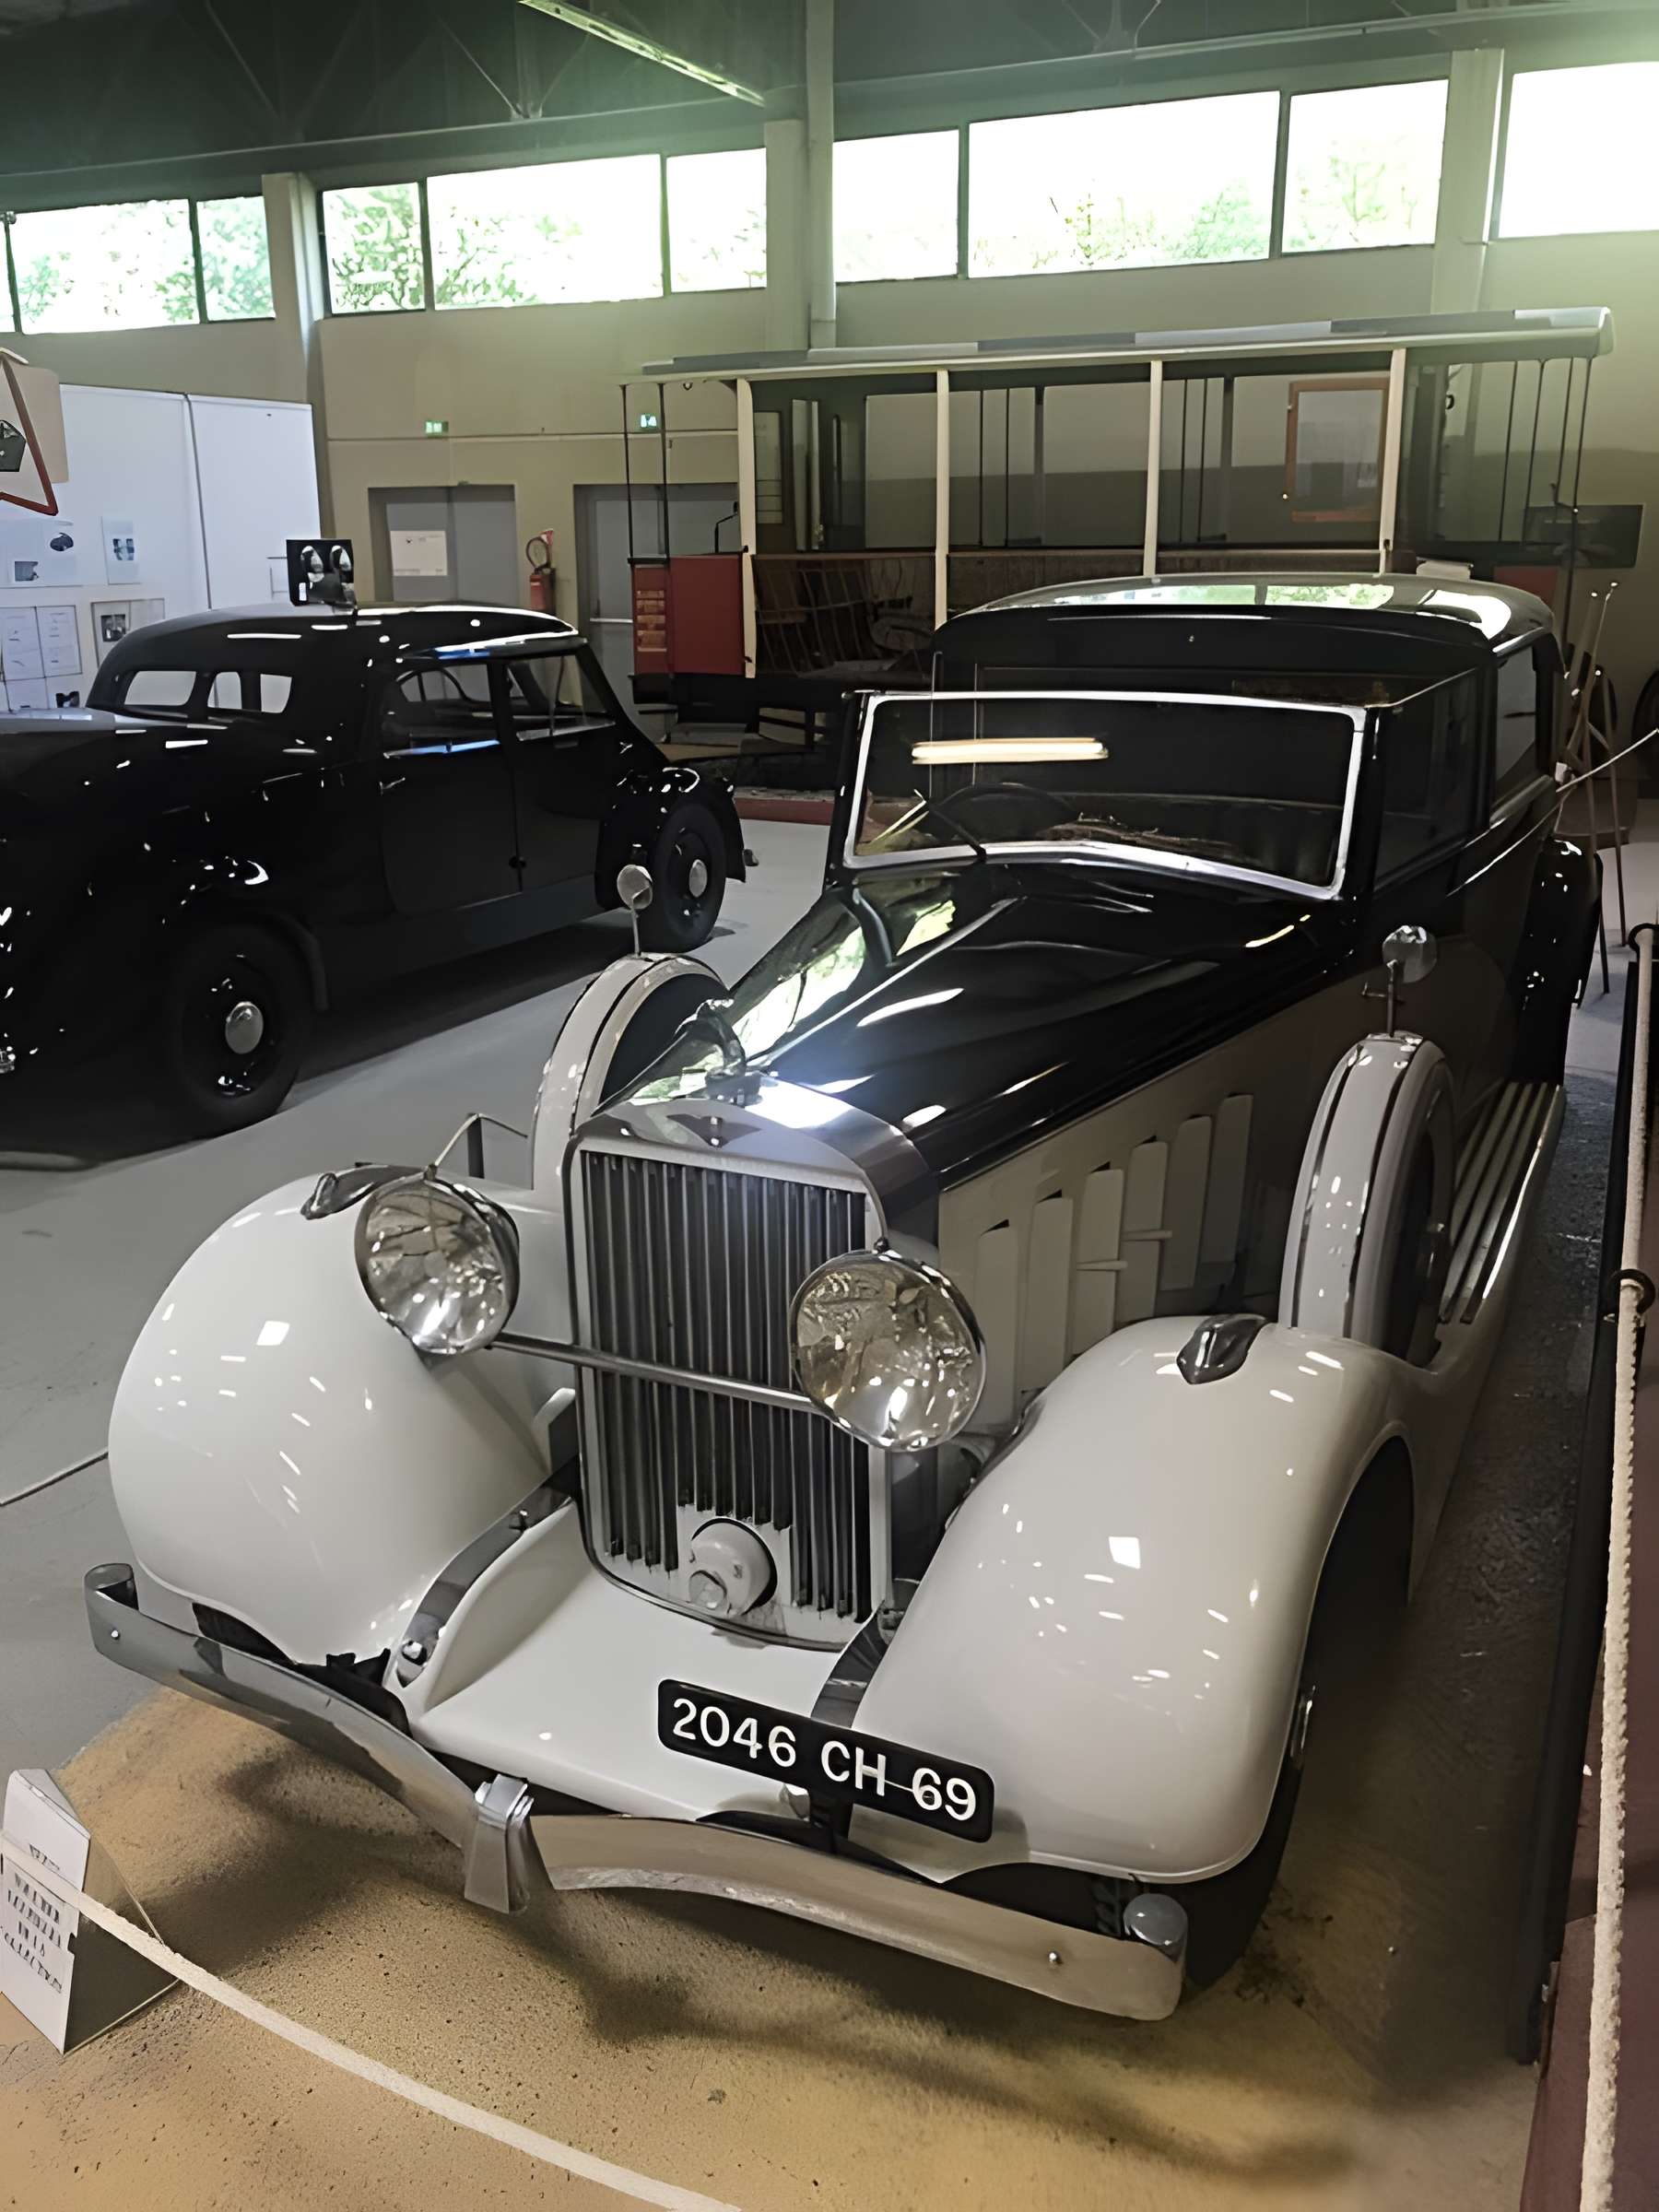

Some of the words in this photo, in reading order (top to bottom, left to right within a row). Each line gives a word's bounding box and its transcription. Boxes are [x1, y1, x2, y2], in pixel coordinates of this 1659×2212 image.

[672, 1698, 797, 1768] 2046
[820, 1740, 887, 1797] CH
[912, 1768, 977, 1821] 69
